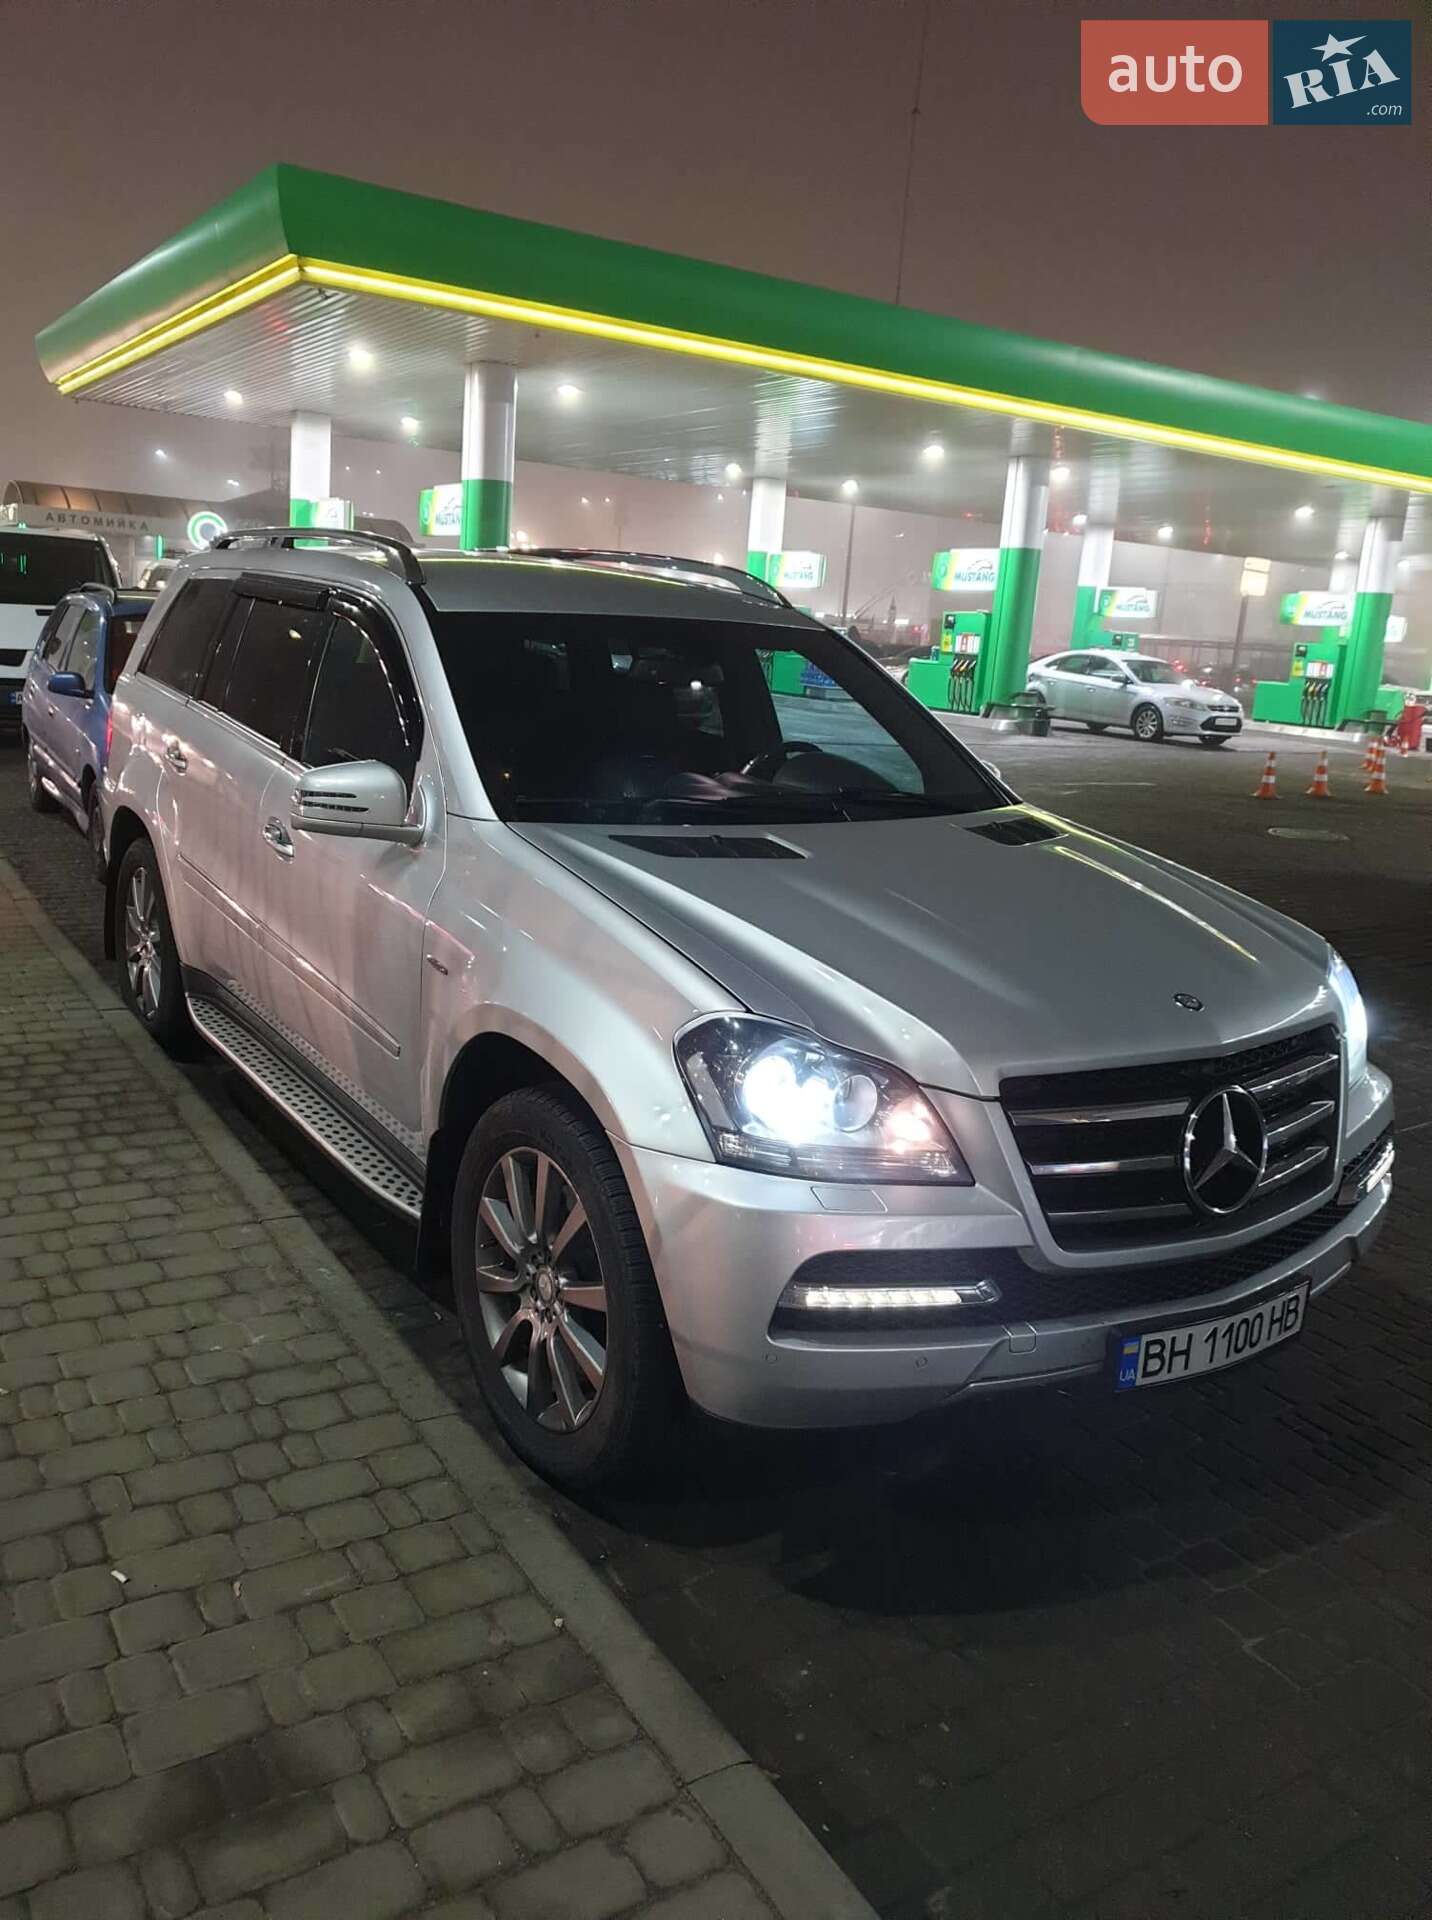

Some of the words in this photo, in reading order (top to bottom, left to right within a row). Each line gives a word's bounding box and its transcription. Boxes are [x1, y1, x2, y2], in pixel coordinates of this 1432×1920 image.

[435, 511, 463, 526] MUSTAN
[954, 570, 996, 584] MUSTANG
[1303, 609, 1348, 621] MUSTANG
[1141, 1333, 1193, 1379] BH
[1204, 1311, 1264, 1364] 1100
[1266, 1294, 1300, 1341] HB
[1119, 1368, 1136, 1383] UA
